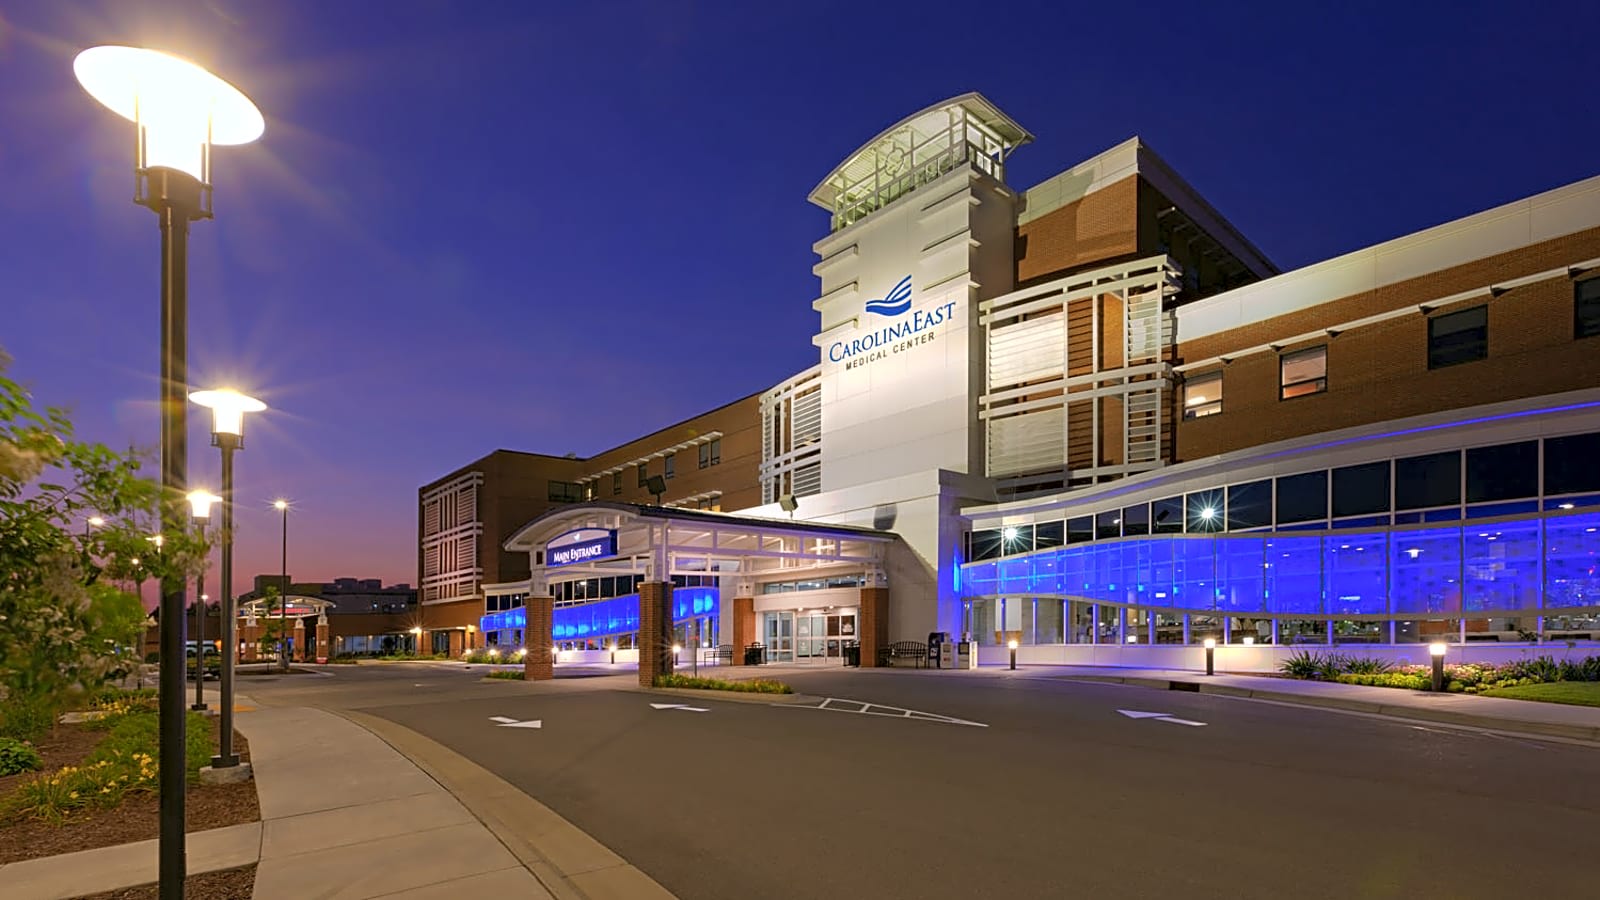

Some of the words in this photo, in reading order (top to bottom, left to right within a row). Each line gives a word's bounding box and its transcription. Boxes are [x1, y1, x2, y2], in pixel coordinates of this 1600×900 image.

[846, 350, 888, 371] MEDICAL
[892, 331, 935, 354] CENTER
[553, 552, 570, 563] MAIN
[570, 545, 602, 561] ENTRANCE
